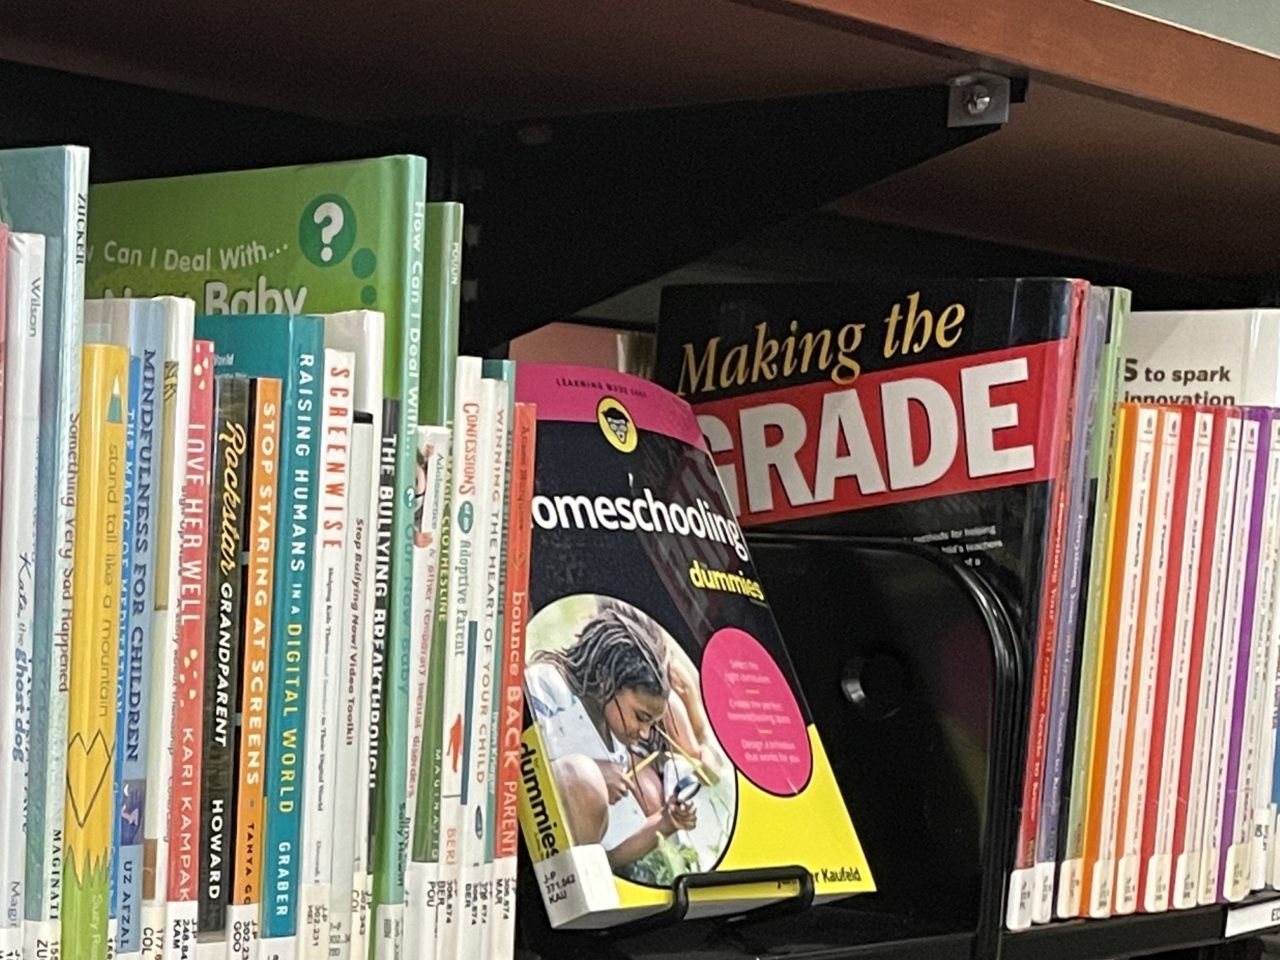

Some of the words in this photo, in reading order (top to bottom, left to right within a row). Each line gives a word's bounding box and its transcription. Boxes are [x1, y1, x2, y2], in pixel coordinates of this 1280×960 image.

[104, 240, 144, 267] Can
[164, 248, 212, 273] Deal
[678, 320, 866, 399] Making
[883, 290, 967, 359] the
[1144, 366, 1166, 383] to
[1171, 365, 1232, 386] spark
[259, 402, 276, 469] STOP
[295, 354, 315, 457] RAISING
[696, 356, 1037, 520] GRADE
[134, 350, 156, 554] MINDFULNESS
[322, 367, 350, 550] SCREENWISE
[218, 420, 247, 577] Rockstar
[290, 469, 310, 572] HUMANS
[529, 488, 750, 562] omeschooling
[132, 562, 146, 616] FOR
[253, 485, 274, 607] STARING
[689, 559, 765, 602] dummies
[251, 618, 266, 650] AT
[291, 584, 302, 599] IN
[509, 591, 527, 677] bounce
[127, 626, 144, 763] CHILDREN
[214, 582, 233, 747] GRANDPARENT
[283, 624, 302, 717] DIGITAL
[246, 661, 264, 785] SCREENS
[504, 685, 522, 768] BACK
[278, 728, 297, 814] WORLD
[208, 801, 224, 899] HOWARD
[500, 781, 519, 858] PARENT
[275, 841, 291, 917] GRABER
